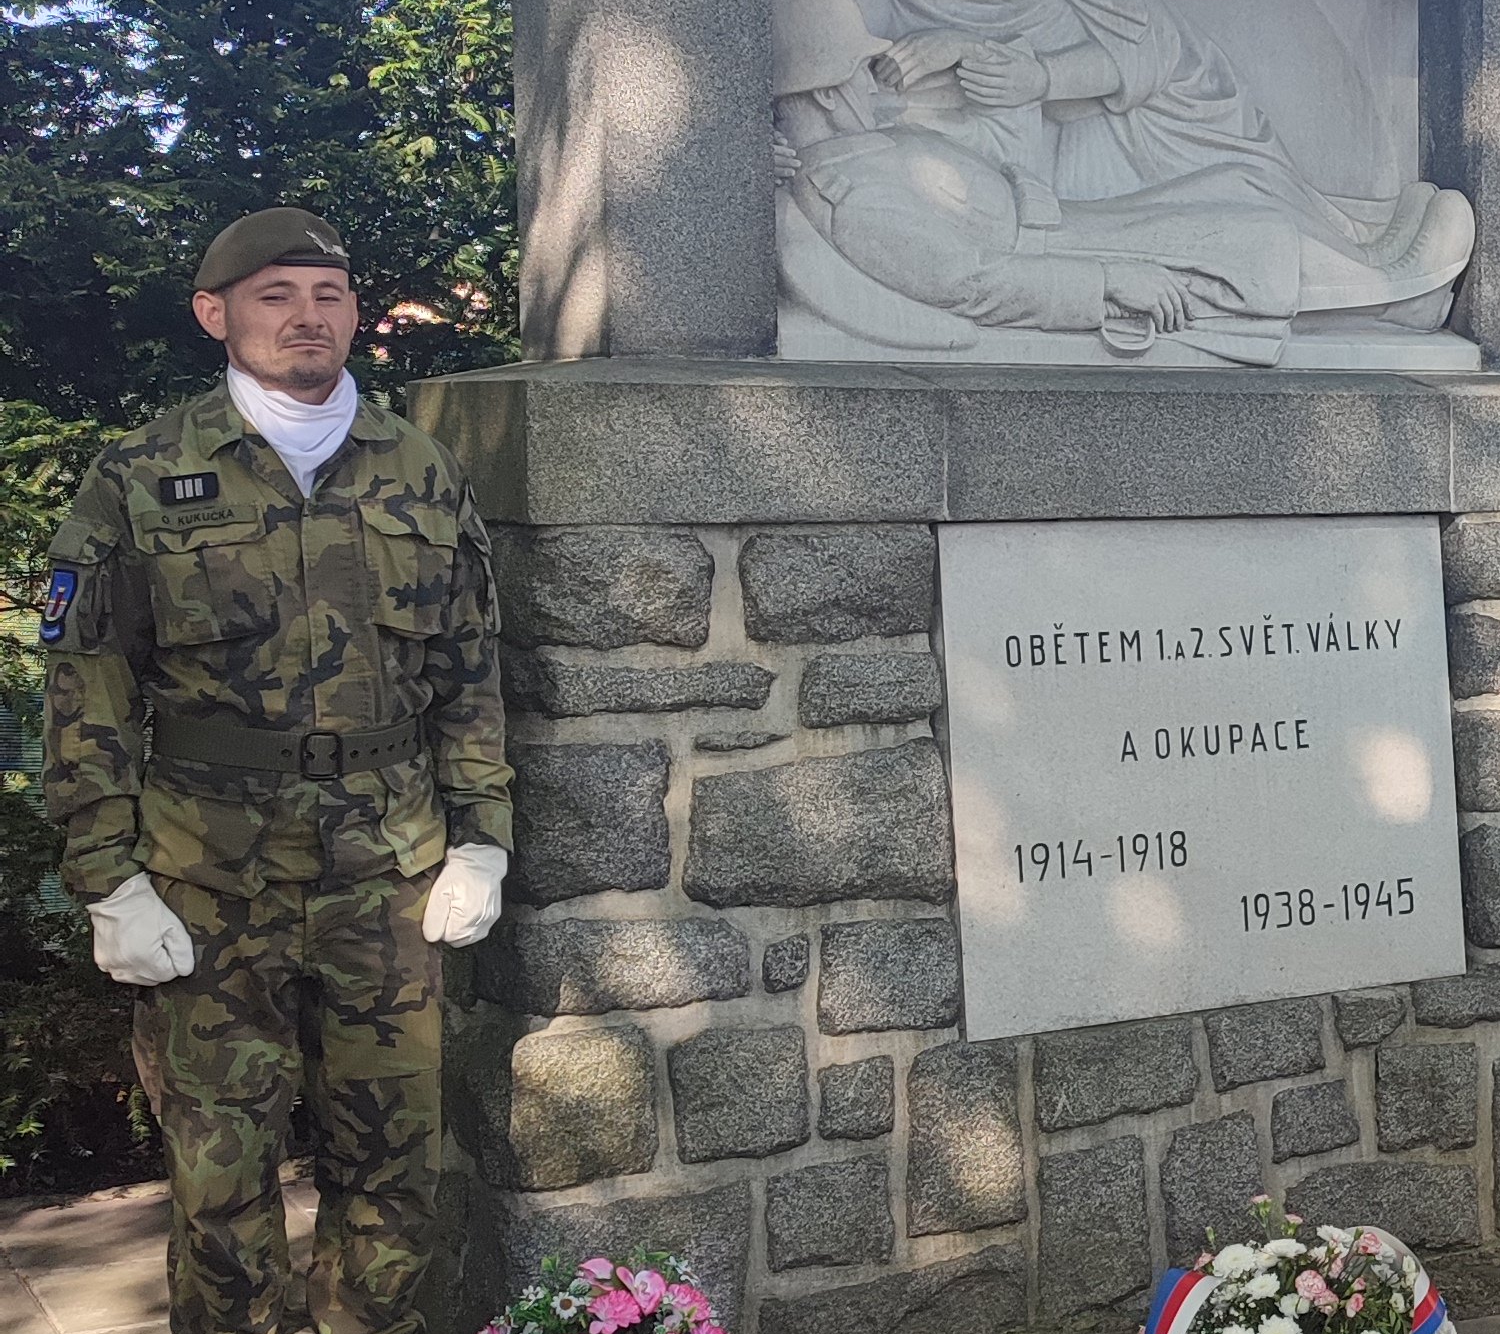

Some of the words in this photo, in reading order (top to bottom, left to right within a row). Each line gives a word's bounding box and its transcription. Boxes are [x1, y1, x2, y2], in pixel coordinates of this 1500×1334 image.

[1005, 622, 1142, 668] OBĚTEM
[1218, 613, 1300, 658] SVĚT.
[1306, 611, 1402, 654] VÁLKY
[1120, 730, 1139, 763] A
[1154, 719, 1310, 760] OKUPACE
[1013, 830, 1188, 884] 1914-1918
[1240, 877, 1415, 933] 1938-1945
